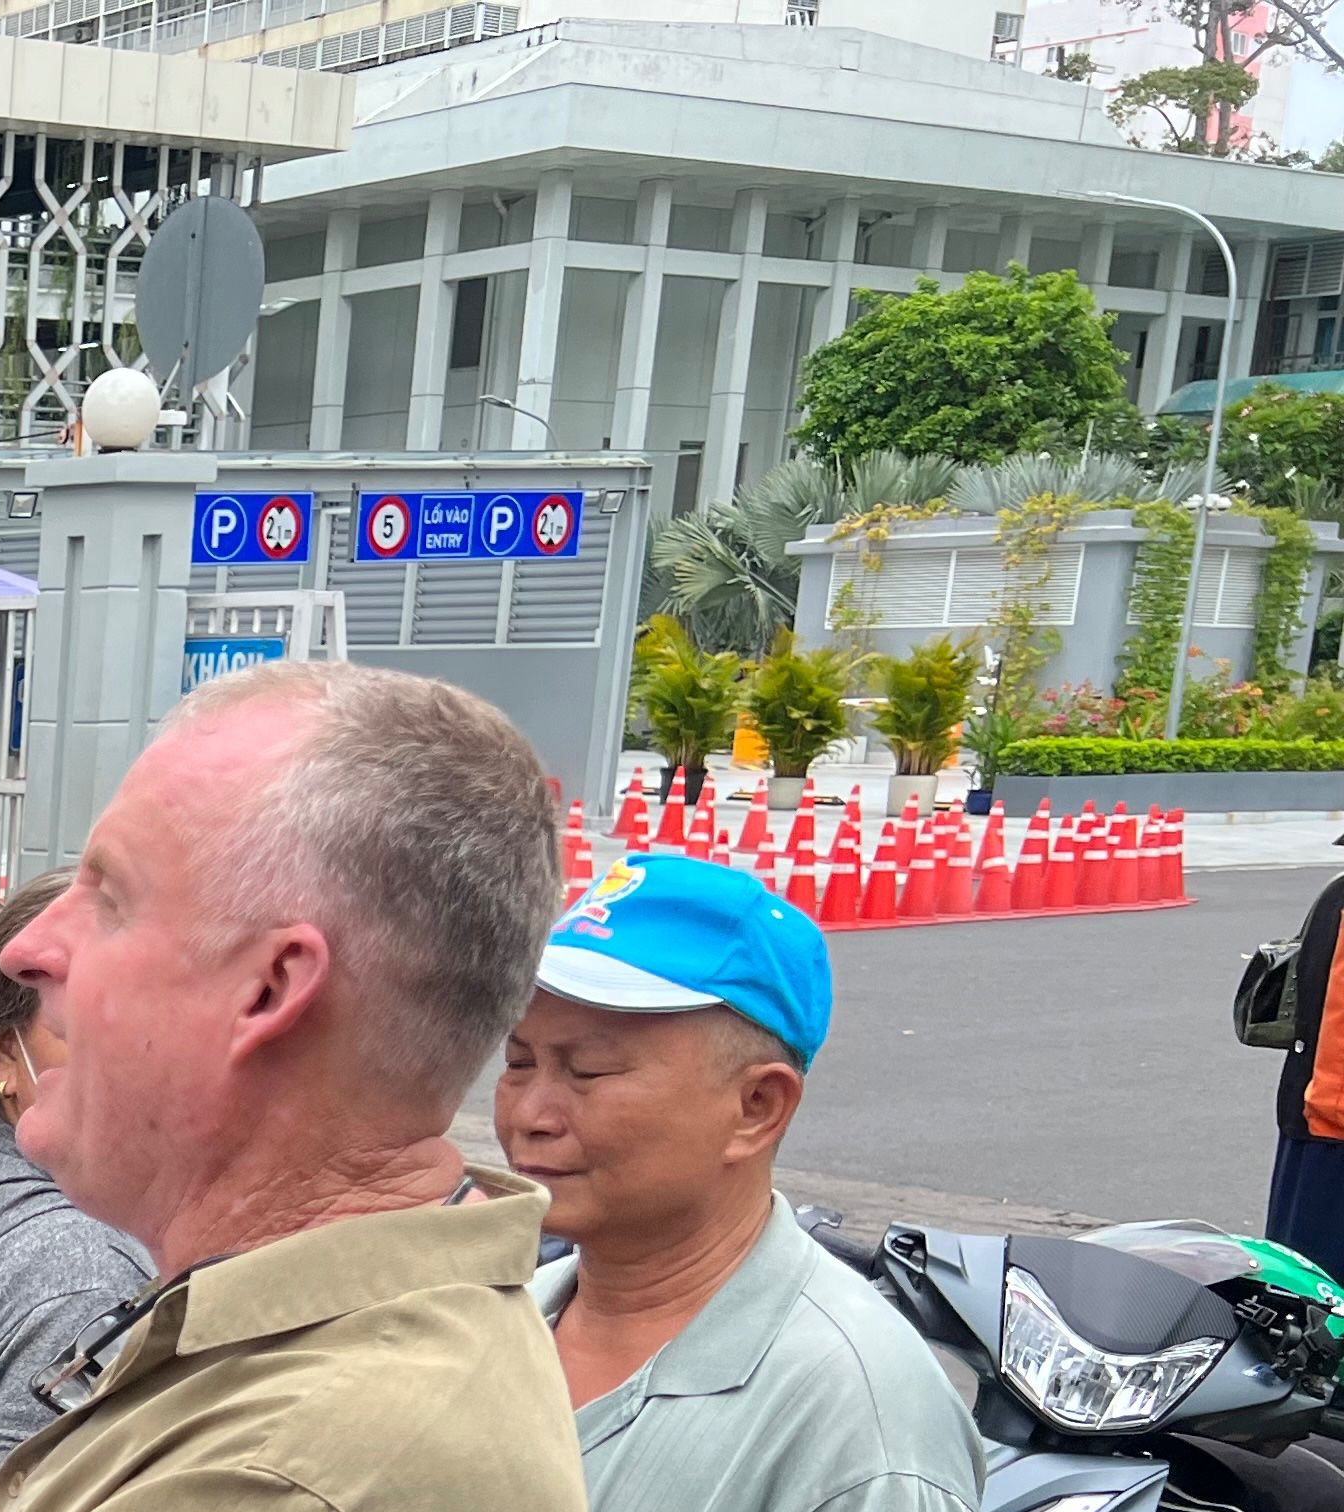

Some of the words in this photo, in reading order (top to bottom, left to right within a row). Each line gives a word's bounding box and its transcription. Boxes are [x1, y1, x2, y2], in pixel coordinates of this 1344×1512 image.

[382, 514, 395, 539] 5
[423, 503, 443, 525] LỐI
[445, 506, 469, 525] VÀO
[490, 506, 514, 545] P
[211, 508, 237, 549] P
[425, 533, 464, 550] ENTRY
